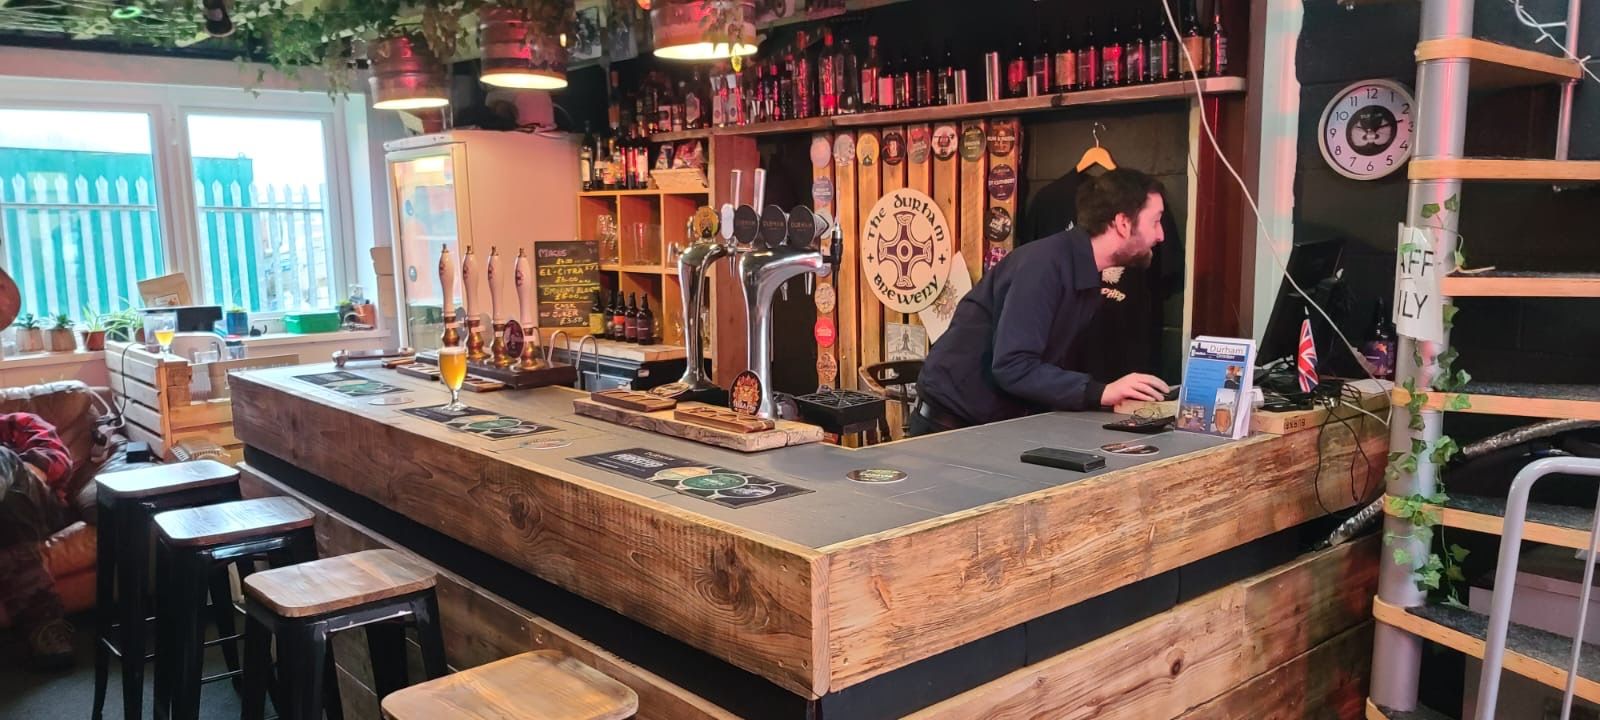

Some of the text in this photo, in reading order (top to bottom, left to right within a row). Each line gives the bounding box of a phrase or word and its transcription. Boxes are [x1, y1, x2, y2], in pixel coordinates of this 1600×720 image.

[1366, 88, 1378, 99] 12
[1350, 96, 1358, 107] 11
[1402, 103, 1410, 114] 2
[1335, 111, 1349, 121] 10
[1329, 127, 1337, 138] 9
[1408, 121, 1414, 133] 3
[1334, 145, 1342, 156] 8
[1399, 140, 1408, 151] 4
[1349, 156, 1357, 167] 7
[1385, 155, 1393, 166] 5
[1366, 161, 1374, 172] 6
[894, 194, 945, 241] DURHAM
[874, 273, 939, 305] BREWERY
[1209, 344, 1244, 355] Durham
